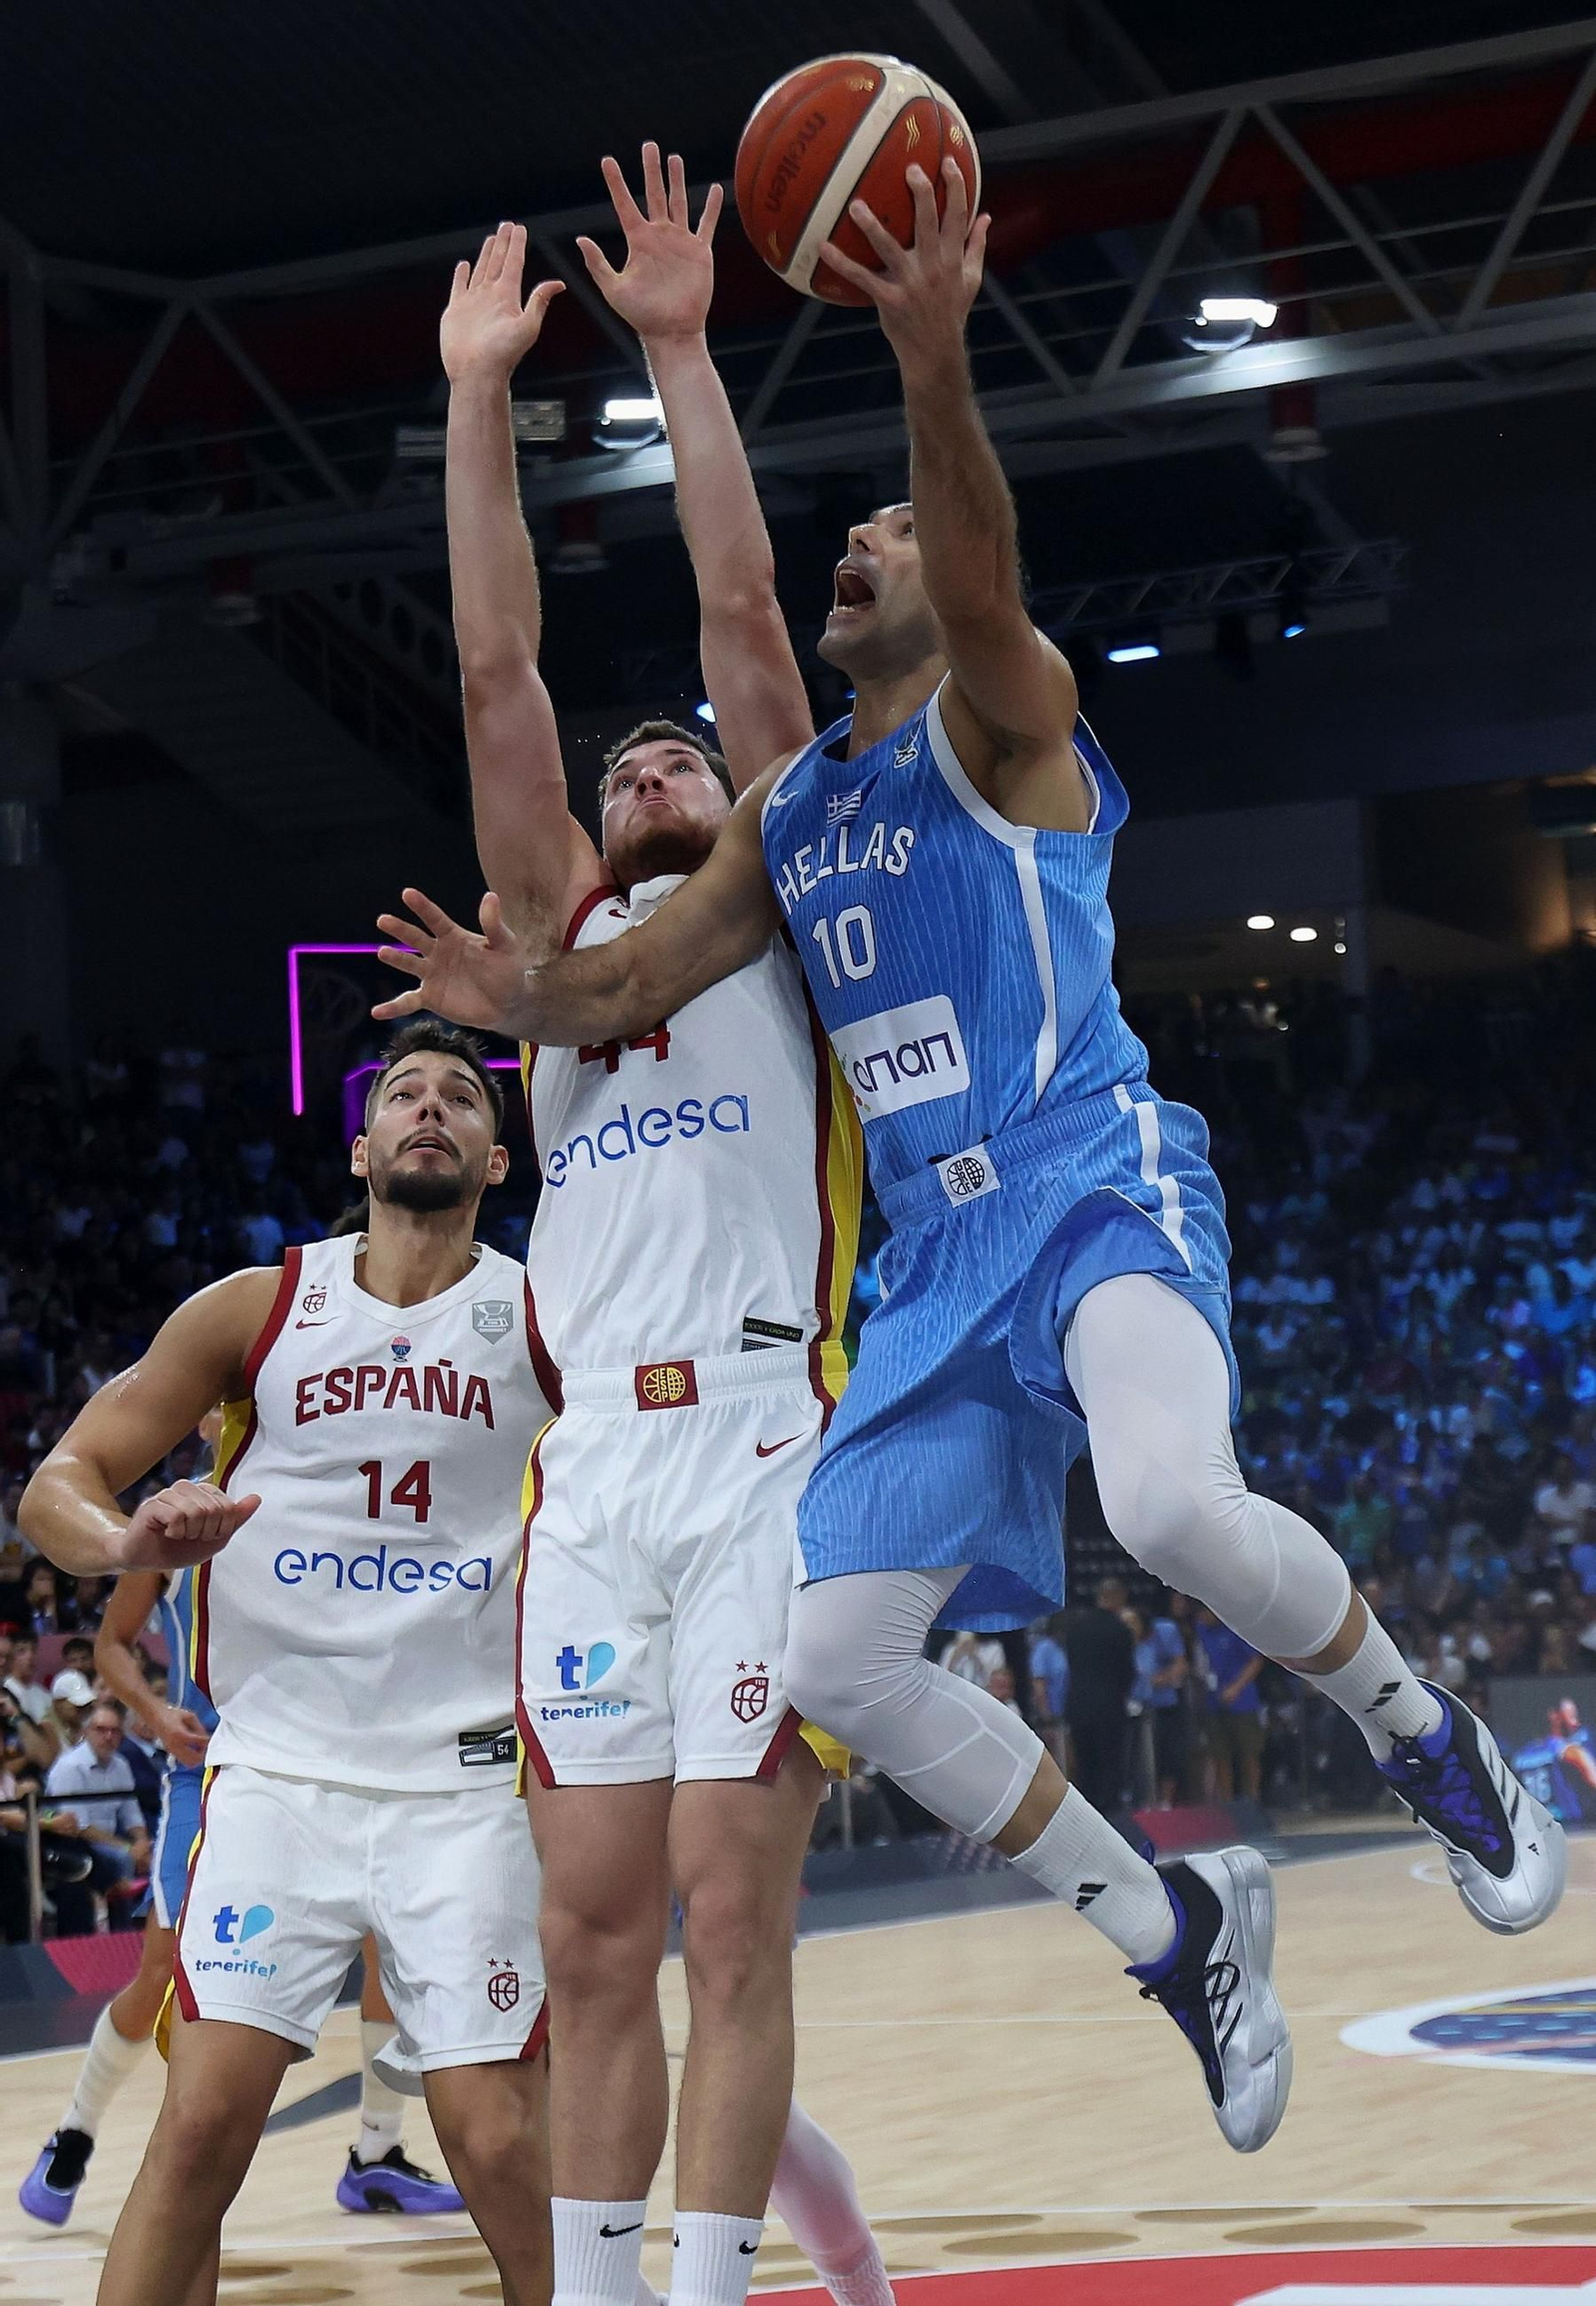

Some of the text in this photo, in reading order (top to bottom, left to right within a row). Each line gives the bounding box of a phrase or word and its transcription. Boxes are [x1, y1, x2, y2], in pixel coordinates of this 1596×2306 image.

[775, 821, 916, 915] HELLAS
[812, 904, 876, 989] 10
[546, 1094, 750, 1188] endesa
[295, 1358, 495, 1430] ESPAÑA
[659, 1367, 668, 1402] ESP
[358, 1460, 432, 1523] 14
[274, 1545, 493, 1594] endesa
[497, 1744, 509, 1755] 54
